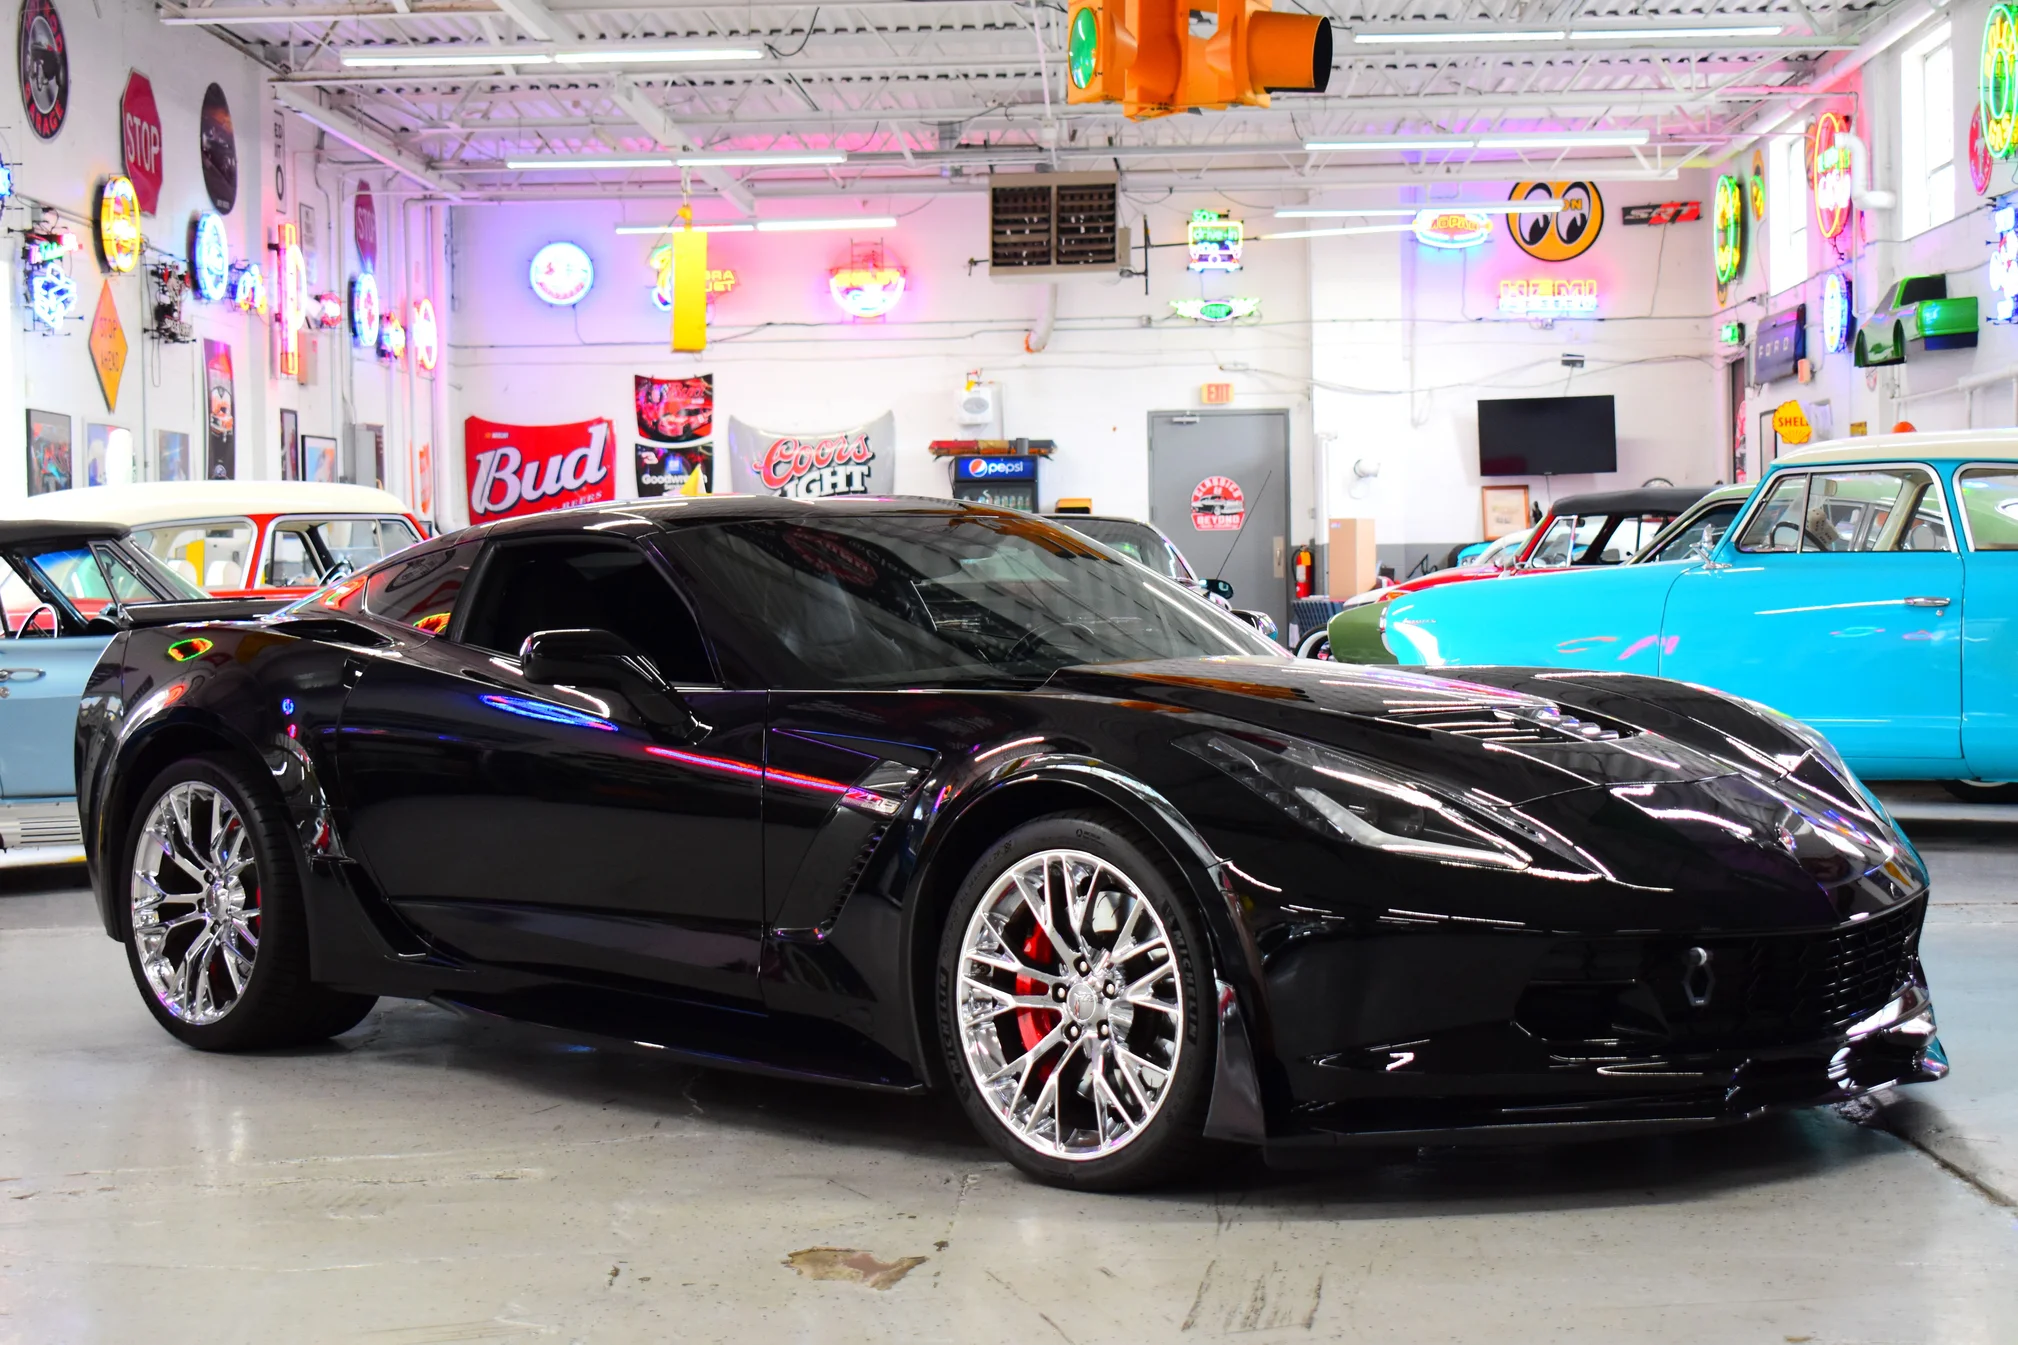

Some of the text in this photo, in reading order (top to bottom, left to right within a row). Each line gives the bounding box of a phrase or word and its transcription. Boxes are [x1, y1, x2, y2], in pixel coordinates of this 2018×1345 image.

[126, 112, 160, 174] STOP
[99, 316, 118, 338] STOP
[1758, 336, 1790, 358] FORD
[1207, 383, 1231, 403] EXIT
[471, 421, 608, 515] Bud
[752, 432, 873, 489] Coors
[988, 461, 1024, 474] pepsi
[1196, 515, 1240, 525] BEYOND
[1173, 929, 1198, 1038] MICHELIN
[939, 971, 962, 1072] MICHELIN
